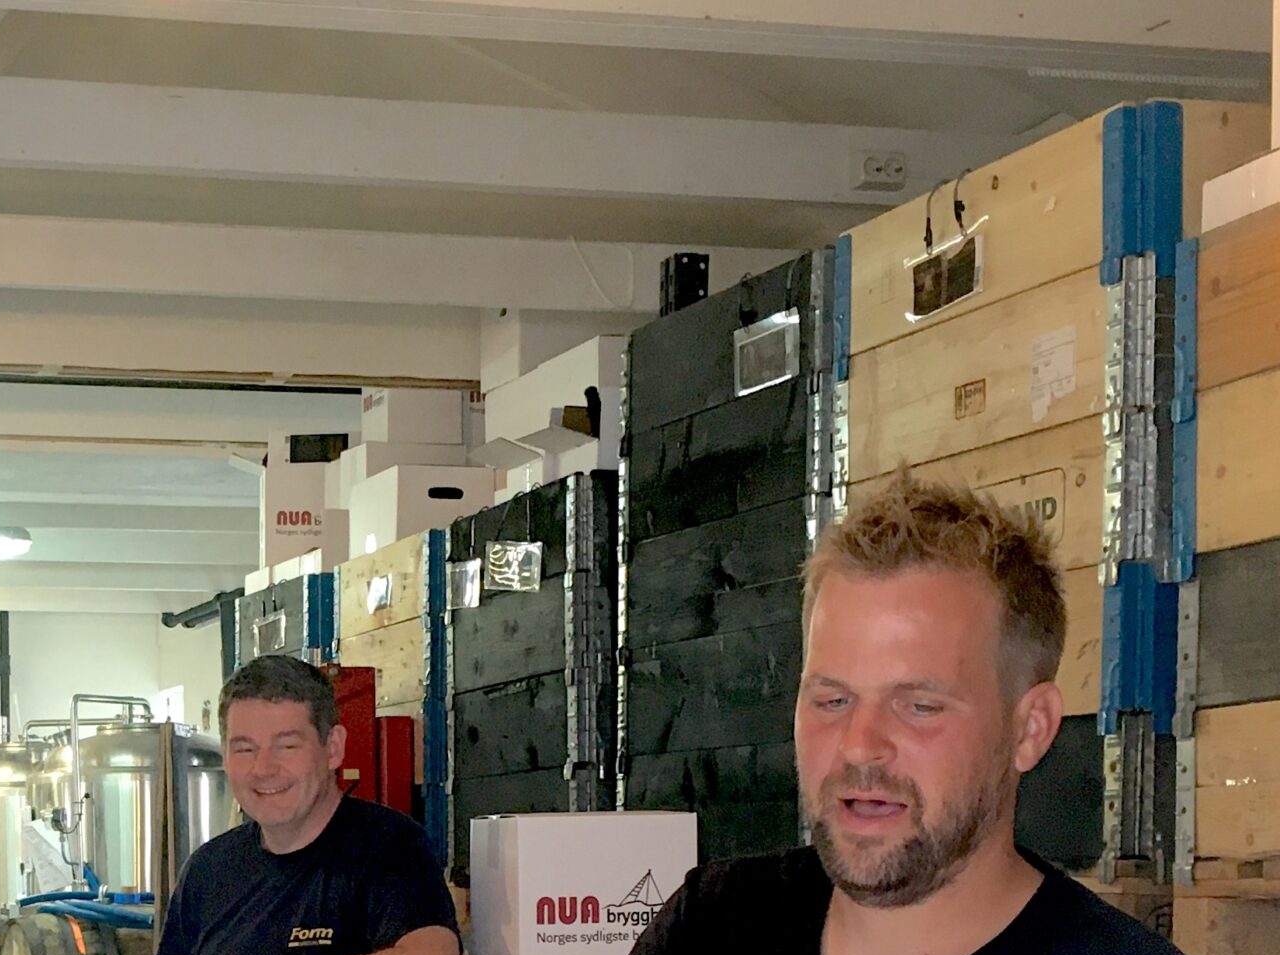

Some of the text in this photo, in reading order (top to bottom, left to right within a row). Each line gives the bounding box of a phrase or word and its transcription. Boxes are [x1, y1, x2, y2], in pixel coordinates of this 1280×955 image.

[276, 510, 312, 526] NUA
[536, 895, 659, 926] NUA bryggh
[290, 927, 334, 941] Form
[536, 932, 578, 946] Norges
[580, 930, 630, 946] sydligste
